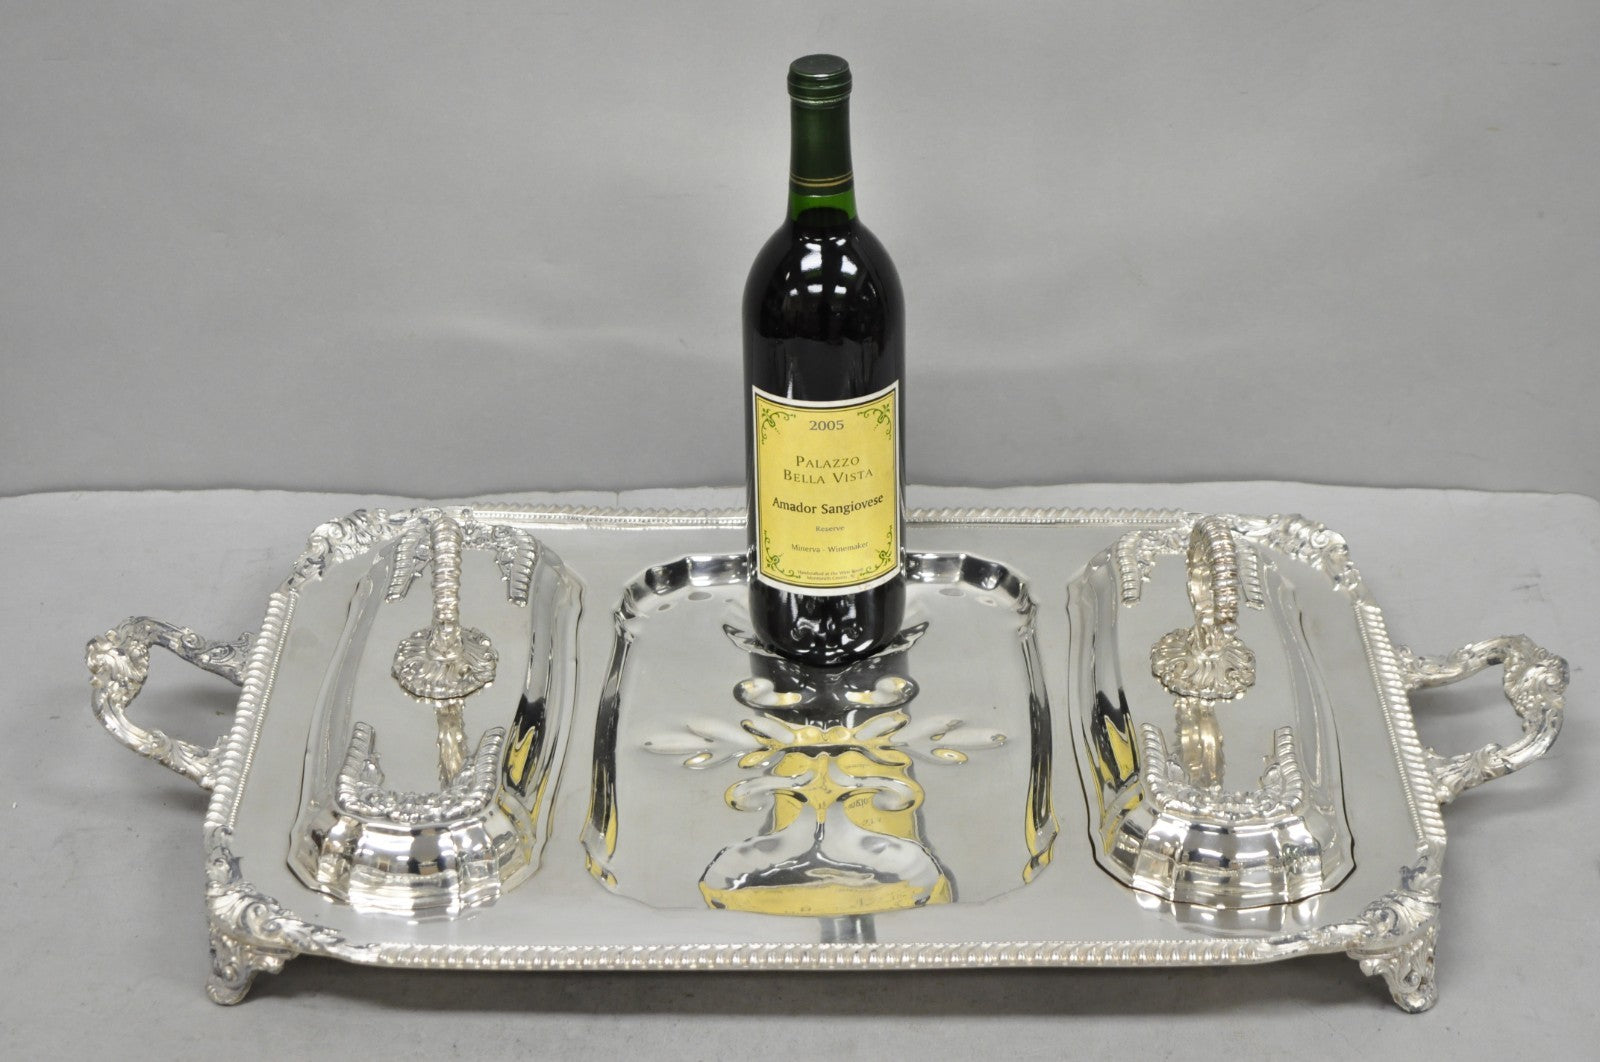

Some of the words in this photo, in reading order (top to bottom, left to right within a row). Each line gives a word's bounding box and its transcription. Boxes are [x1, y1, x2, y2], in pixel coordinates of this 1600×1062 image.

[809, 419, 845, 431] 2005
[796, 455, 860, 469] PALAZZO
[783, 468, 826, 485] BELLA
[832, 468, 874, 484] VISTA
[772, 496, 817, 514] Amador
[821, 494, 884, 516] Sangiovese
[791, 543, 821, 553] Minerva
[827, 541, 869, 553] Winemaker
